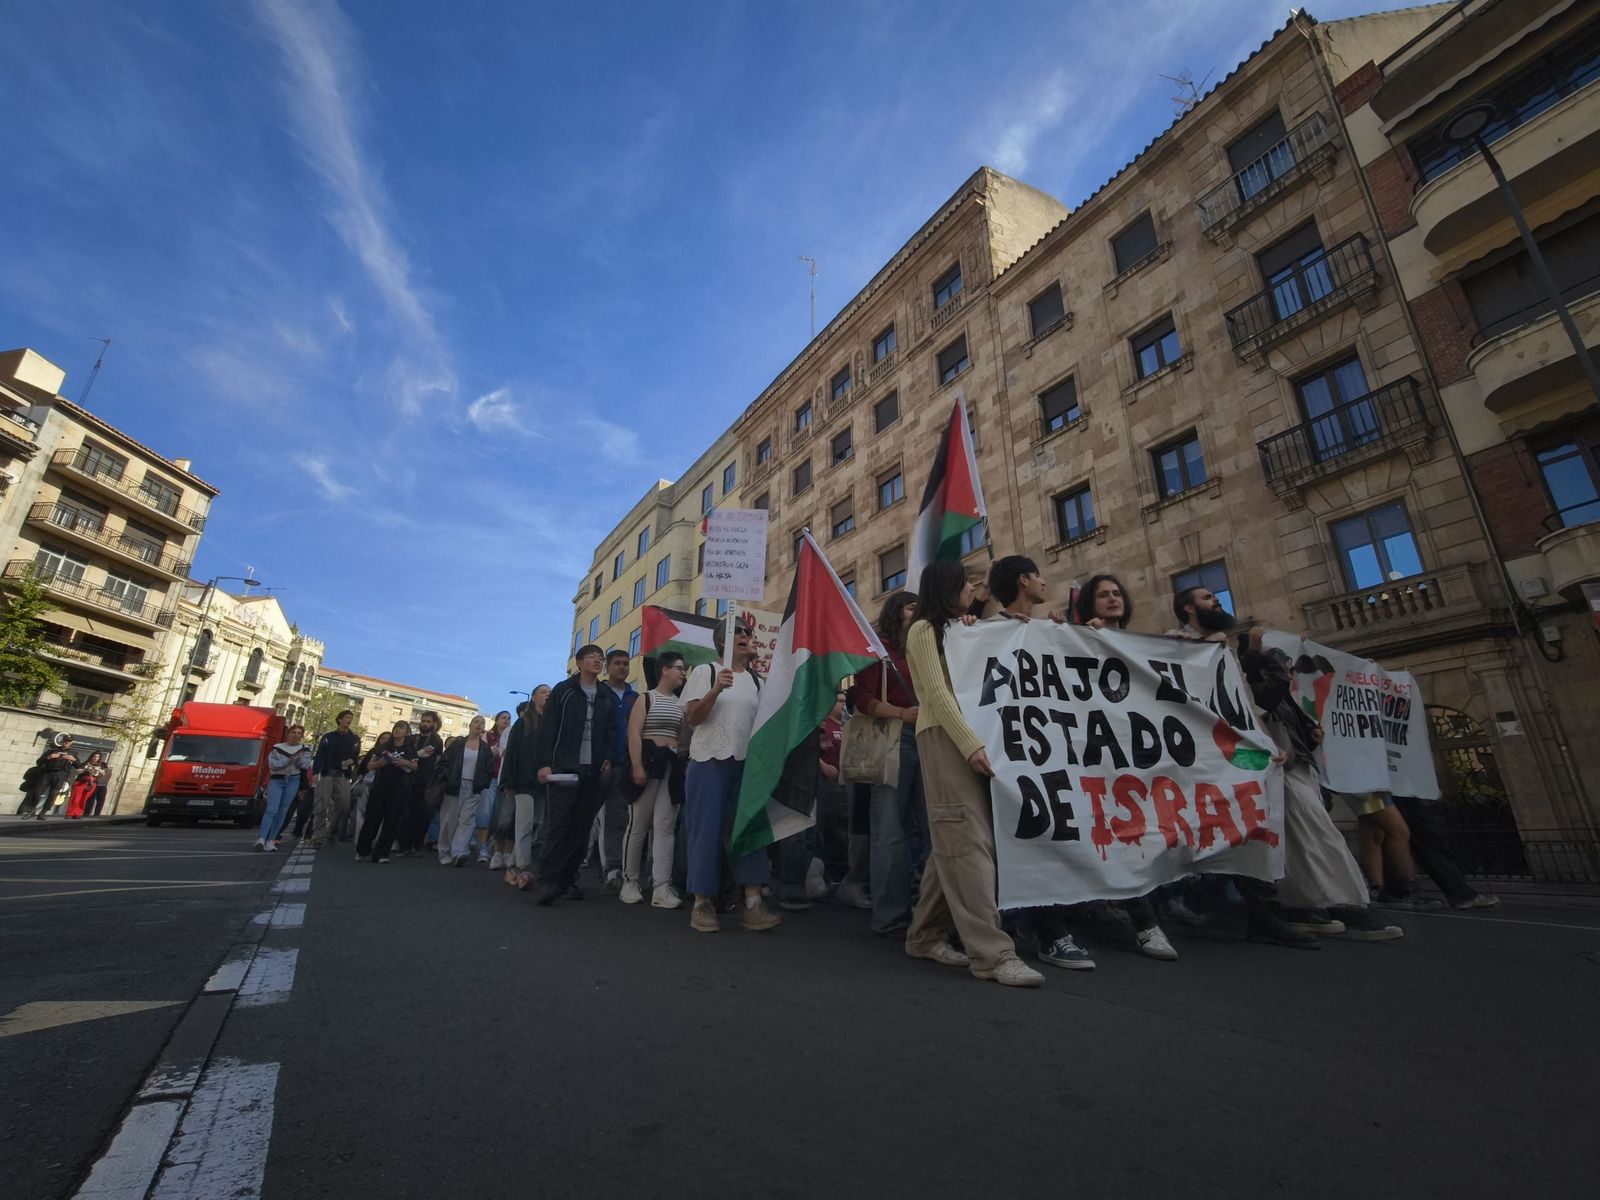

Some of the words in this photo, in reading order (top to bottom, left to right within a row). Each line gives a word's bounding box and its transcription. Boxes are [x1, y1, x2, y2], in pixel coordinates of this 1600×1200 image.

[742, 611, 756, 630] NO
[979, 649, 1131, 706] ABAJO
[1345, 670, 1380, 687] HUELG
[996, 705, 1196, 770] ESTADO
[1331, 711, 1356, 738] POR
[192, 765, 226, 774] Mahou
[1014, 769, 1080, 841] DE
[1079, 773, 1281, 855] ISRAE
